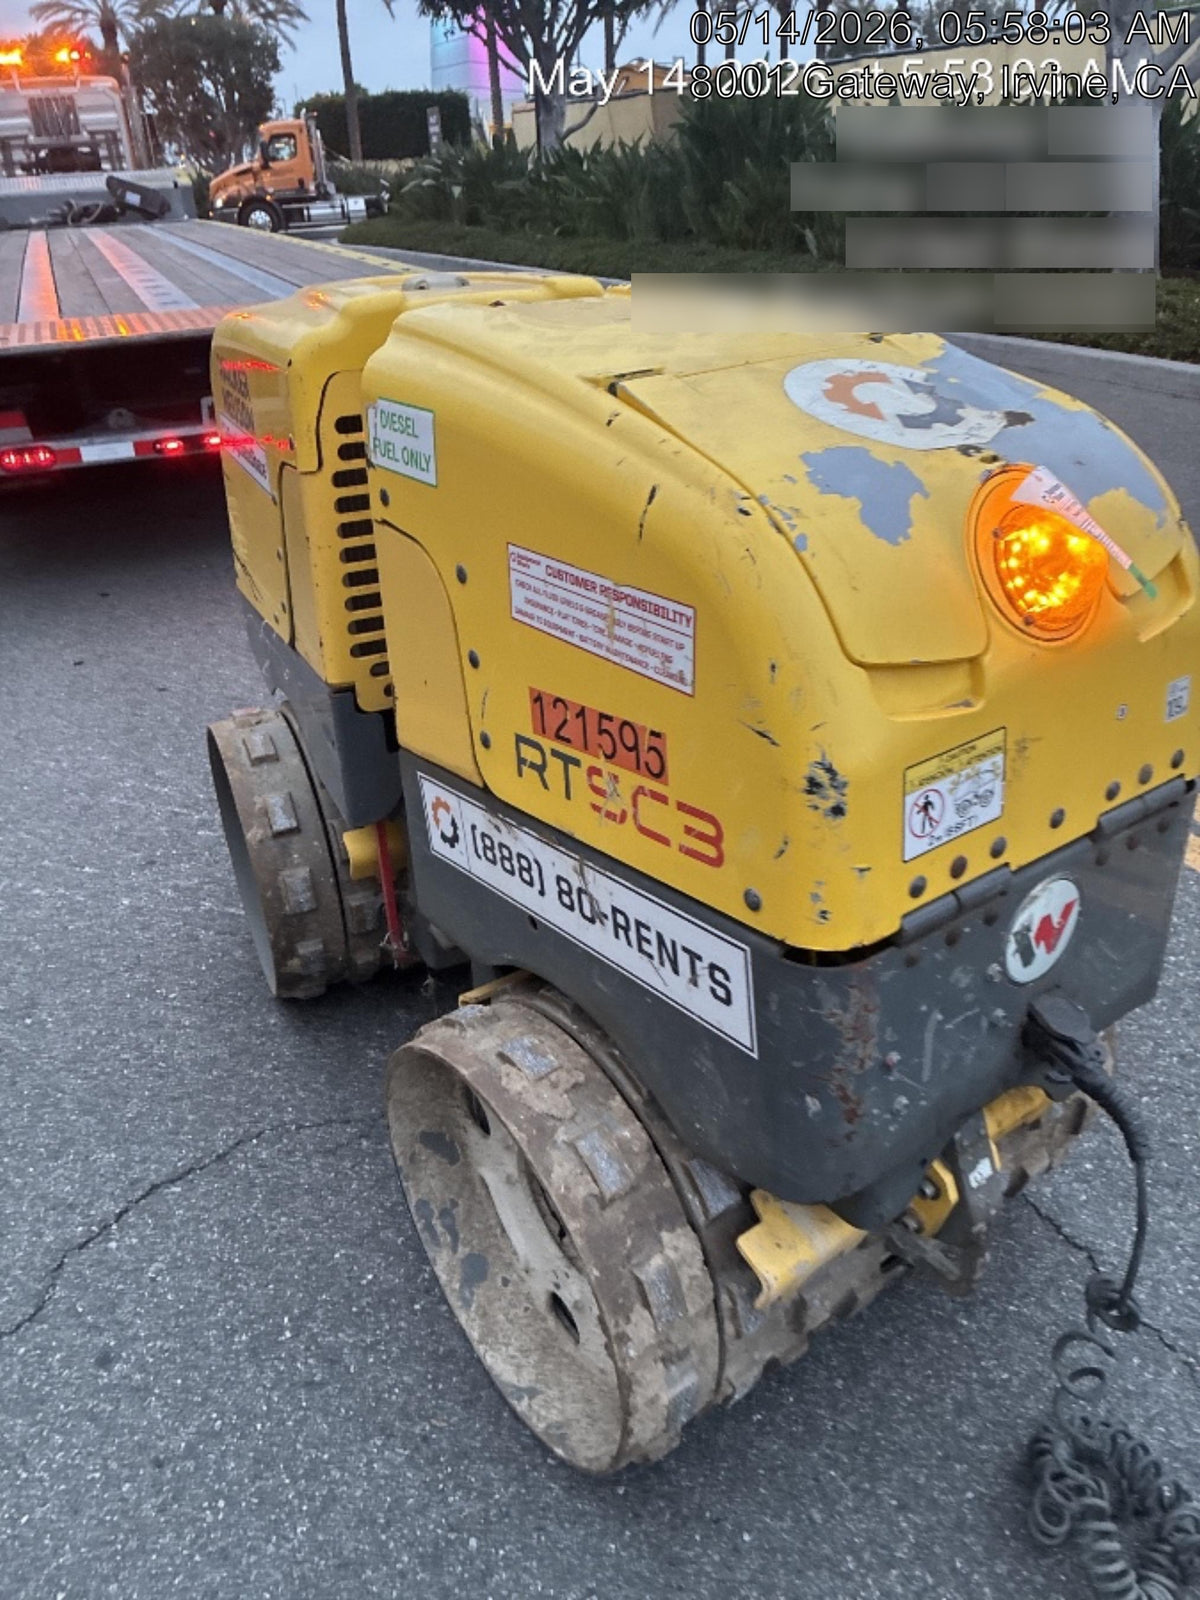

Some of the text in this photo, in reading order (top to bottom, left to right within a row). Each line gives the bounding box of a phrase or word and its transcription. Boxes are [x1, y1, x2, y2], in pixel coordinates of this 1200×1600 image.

[373, 436, 432, 473] FUEL ONLY
[380, 408, 419, 438] DIESEL
[545, 564, 598, 594] CUSTOMER
[599, 583, 692, 629] RESPONSIBILITY
[533, 692, 665, 780] 121595
[470, 824, 733, 1007] (888) 80-RENTS
